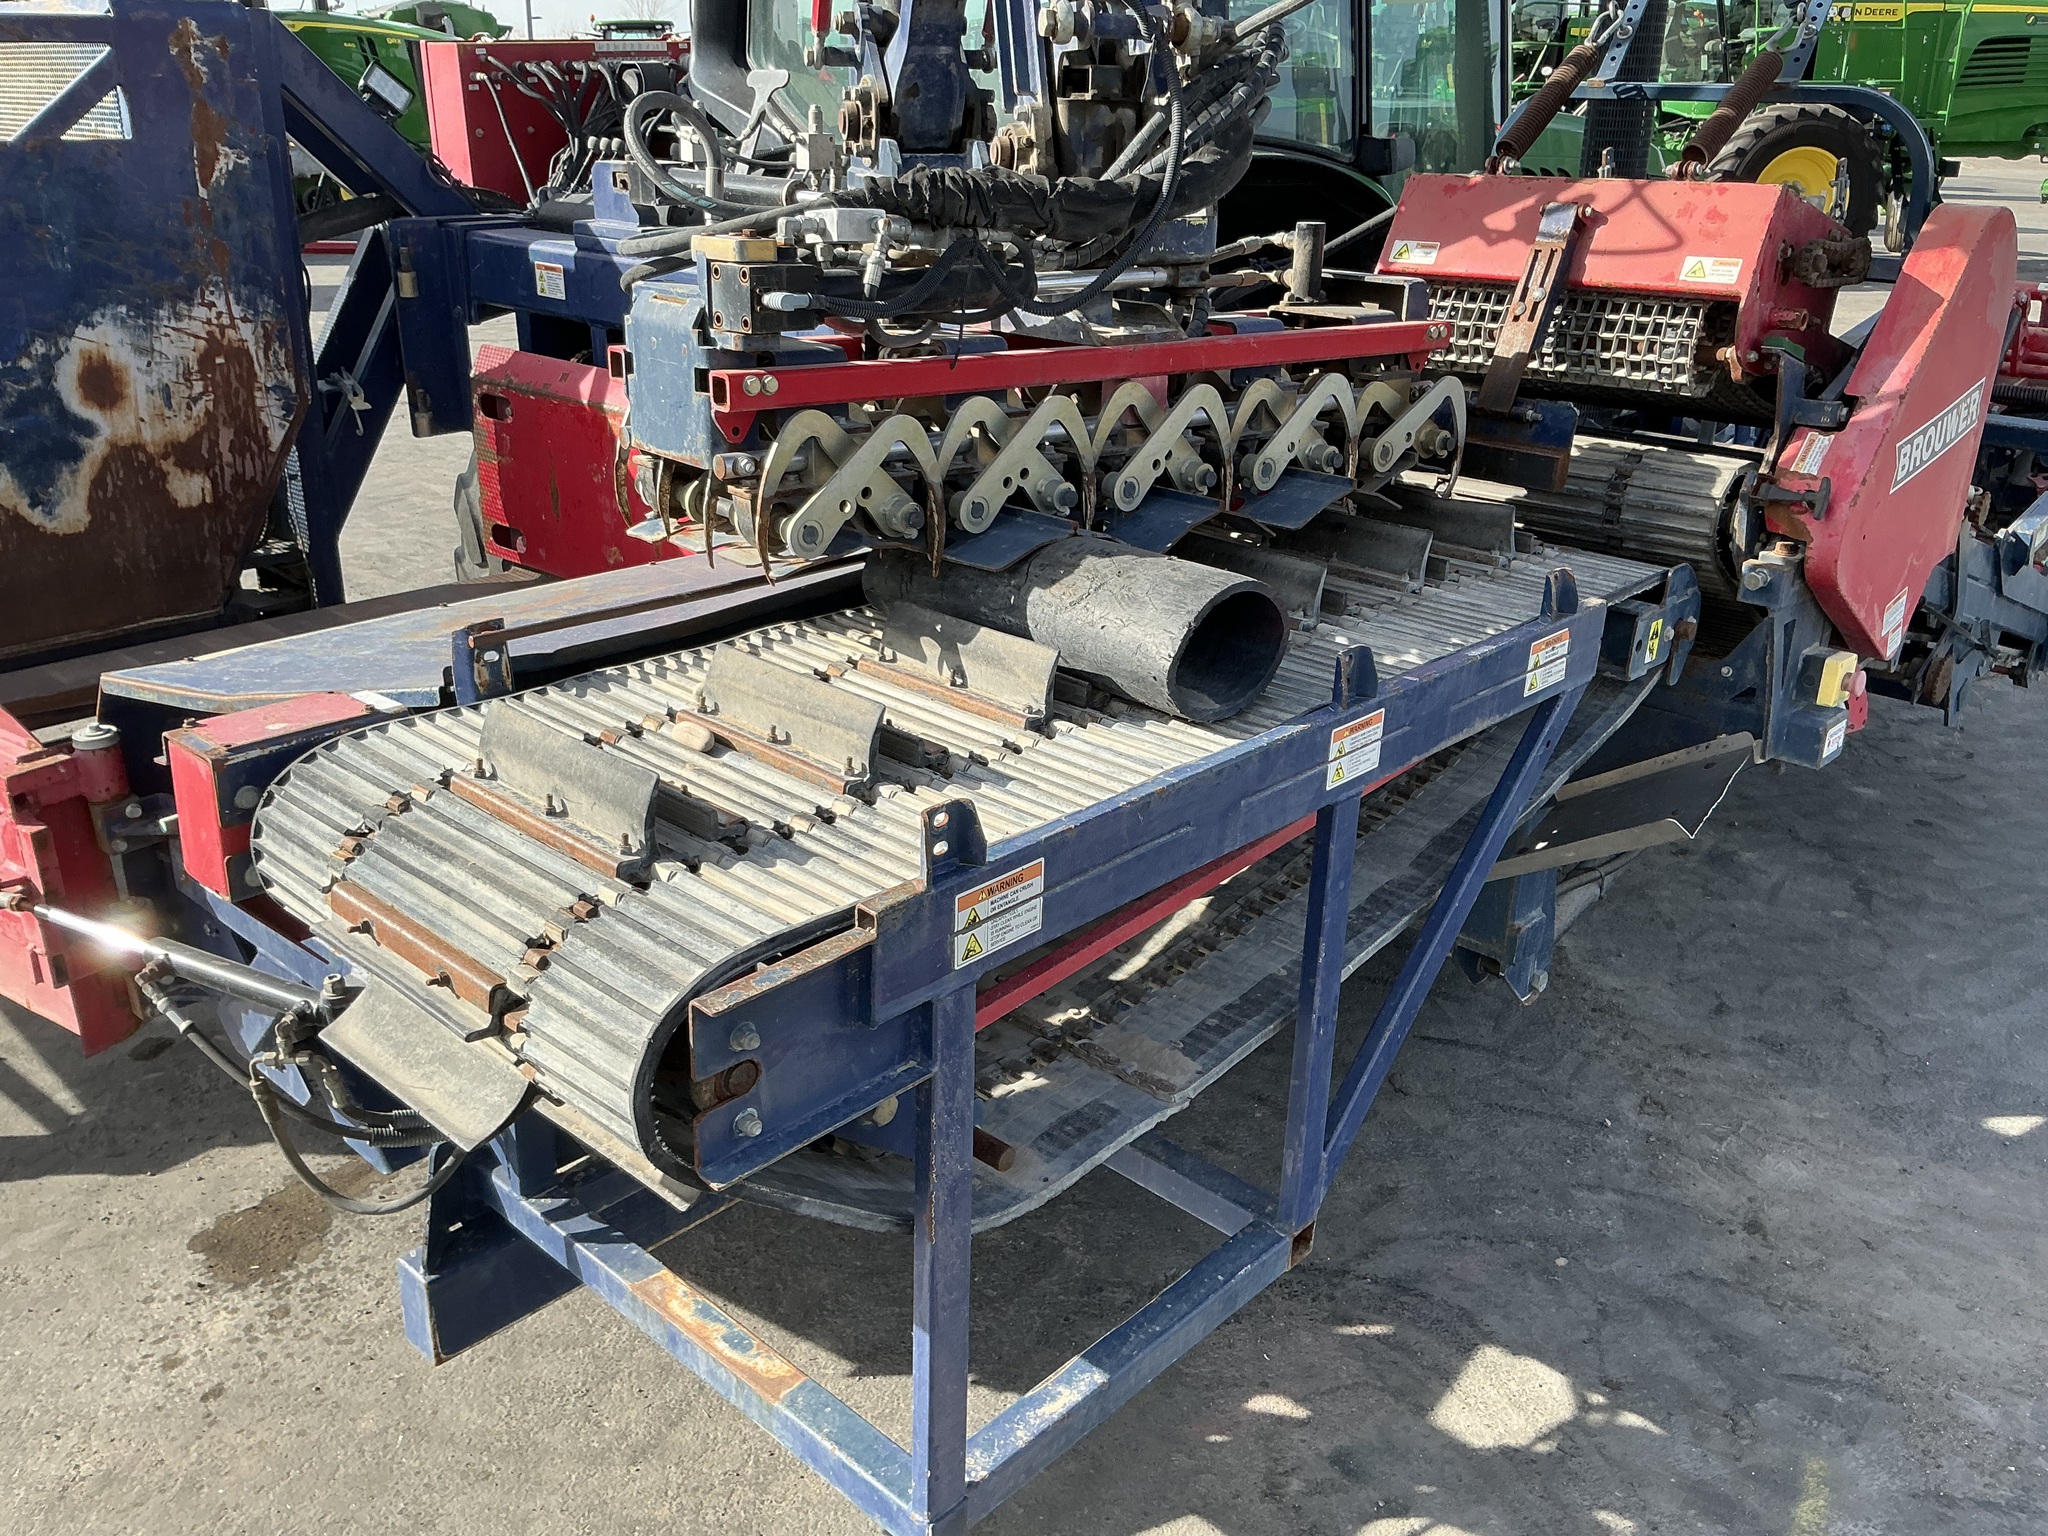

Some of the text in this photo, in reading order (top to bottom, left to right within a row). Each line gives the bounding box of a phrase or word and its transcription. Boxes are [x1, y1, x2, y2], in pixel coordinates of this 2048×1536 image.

[1864, 7, 1899, 16] DEERE
[1896, 389, 1980, 482] BROUWER
[1348, 718, 1373, 735] WARNING
[986, 873, 1024, 897] WARNING
[990, 882, 1034, 906] MACHINE CAN CRUSH
[1000, 915, 1013, 927] CLEAR
[1012, 910, 1024, 922] WHILE
[1023, 904, 1038, 917] ENGINE
[1001, 926, 1015, 938] ENGINE
